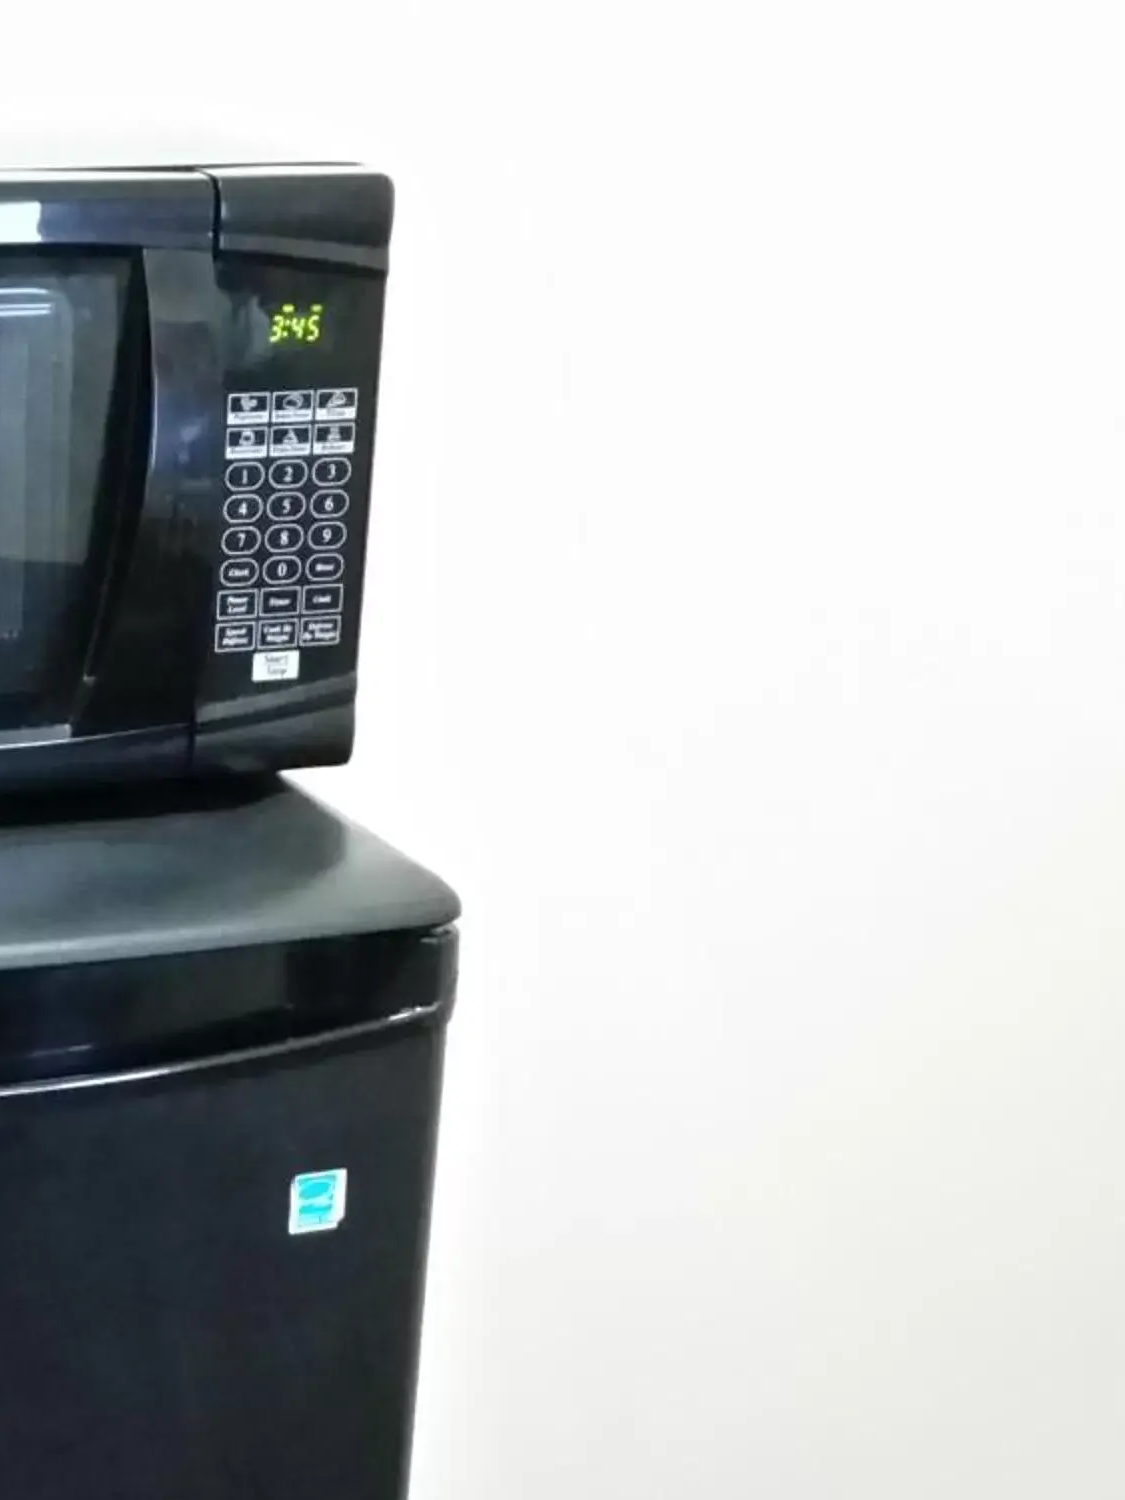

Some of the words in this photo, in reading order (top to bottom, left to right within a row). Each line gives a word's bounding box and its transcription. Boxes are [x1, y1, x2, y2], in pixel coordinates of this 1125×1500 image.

[268, 314, 320, 343] 3:45
[283, 465, 293, 483] 2
[327, 463, 336, 480] 3
[238, 501, 248, 516] 4
[282, 498, 291, 514] 5
[324, 495, 334, 511] 6
[237, 532, 246, 548] 7
[280, 529, 289, 546] 8
[322, 527, 332, 543] 9
[277, 562, 288, 577] 0
